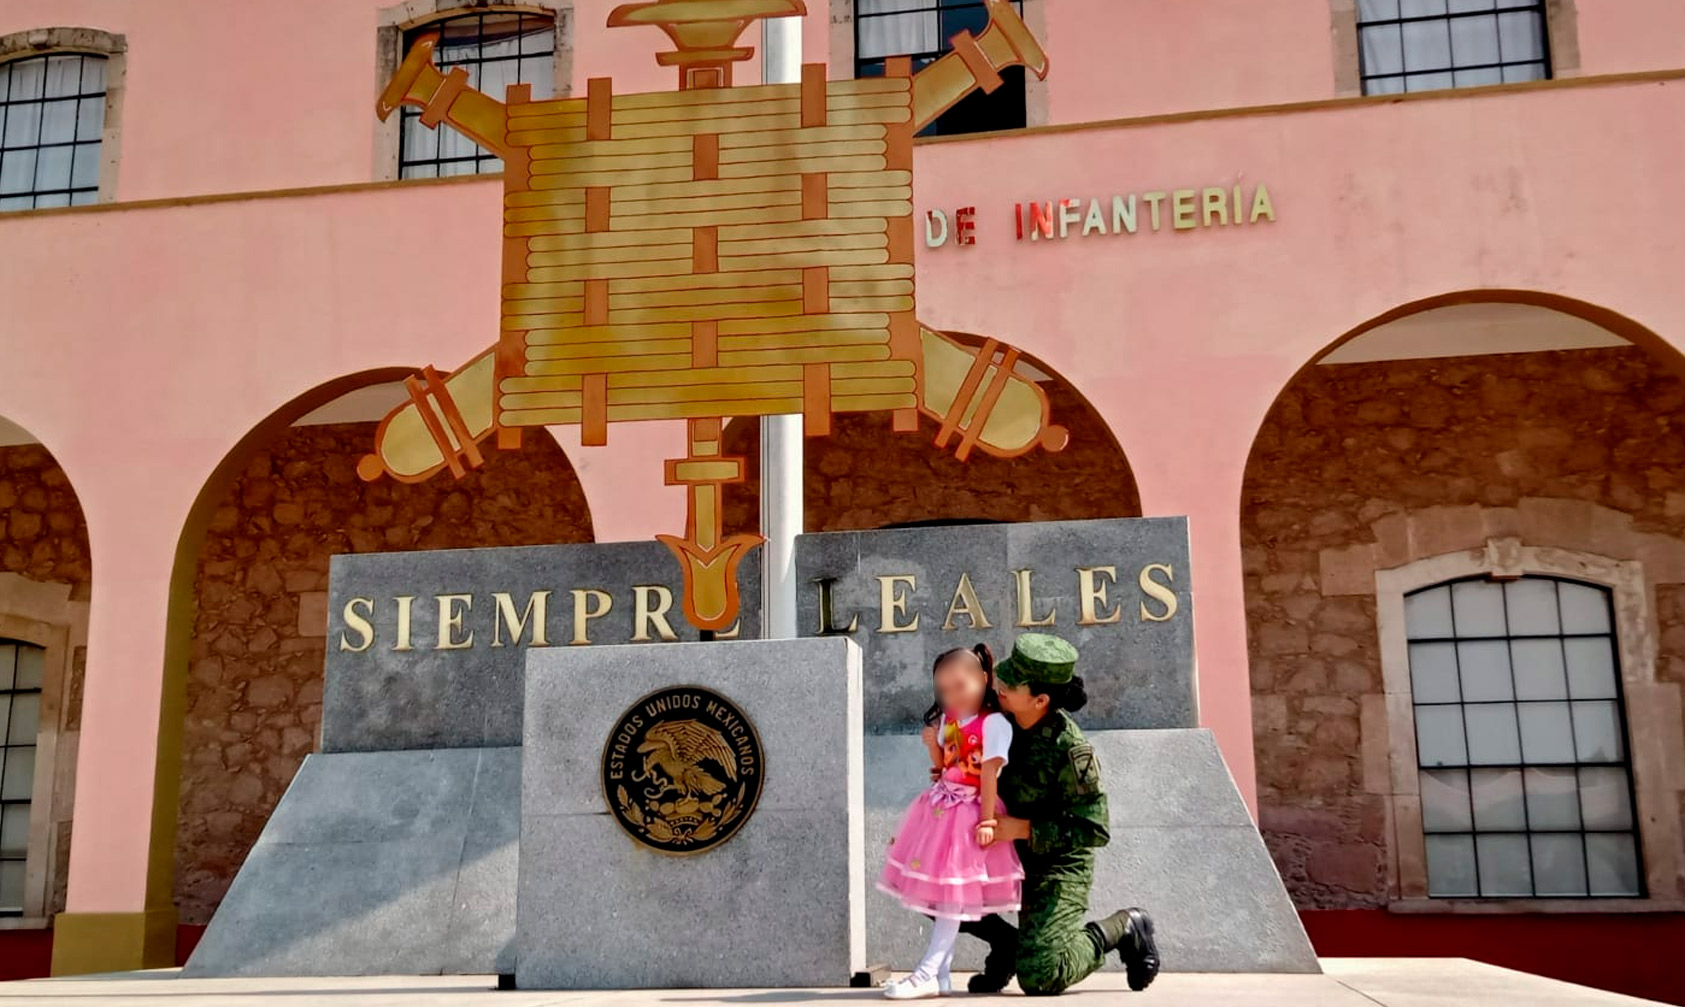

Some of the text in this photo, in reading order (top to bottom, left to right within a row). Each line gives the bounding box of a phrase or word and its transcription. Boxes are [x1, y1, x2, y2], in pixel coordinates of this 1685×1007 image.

[925, 206, 976, 248] DE
[340, 562, 1180, 652] SIEMPR LEALES
[610, 694, 755, 780] ESTADOS UNIDOS MEXICANOS
